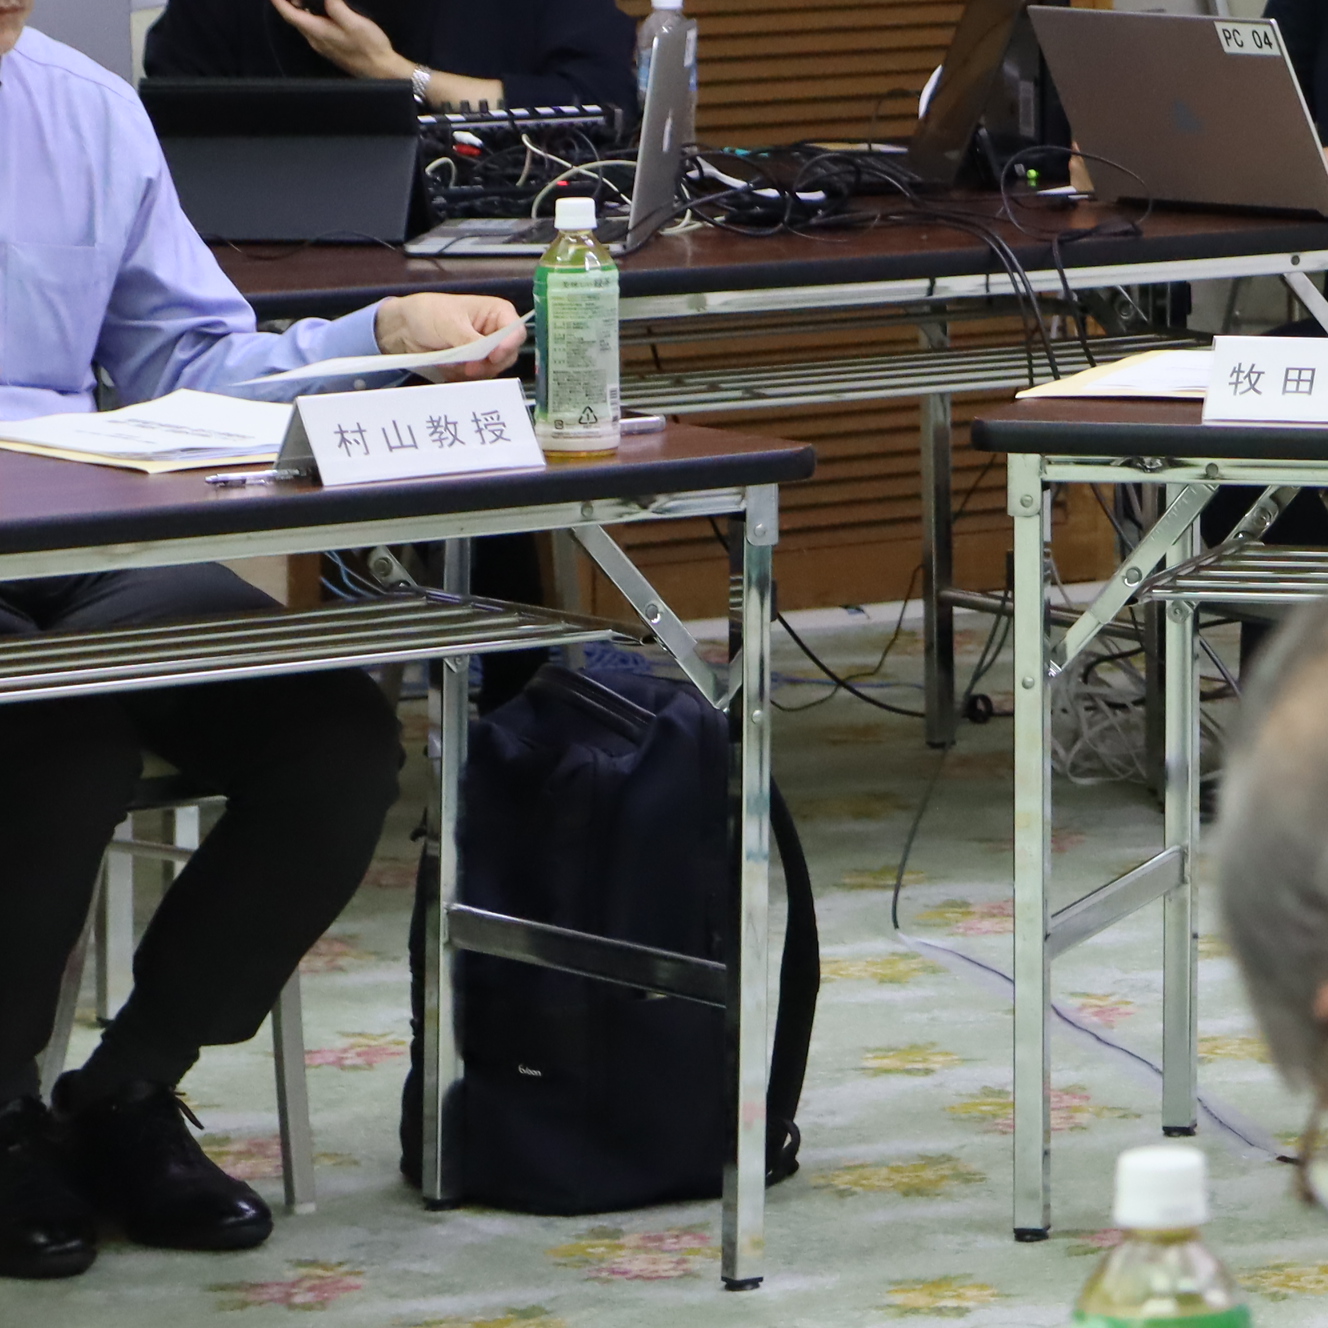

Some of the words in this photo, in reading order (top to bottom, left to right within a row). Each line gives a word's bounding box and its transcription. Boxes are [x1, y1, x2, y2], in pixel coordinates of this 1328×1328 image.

[1221, 26, 1245, 48] PC
[1250, 29, 1273, 51] 04
[333, 410, 513, 457] 村山教授
